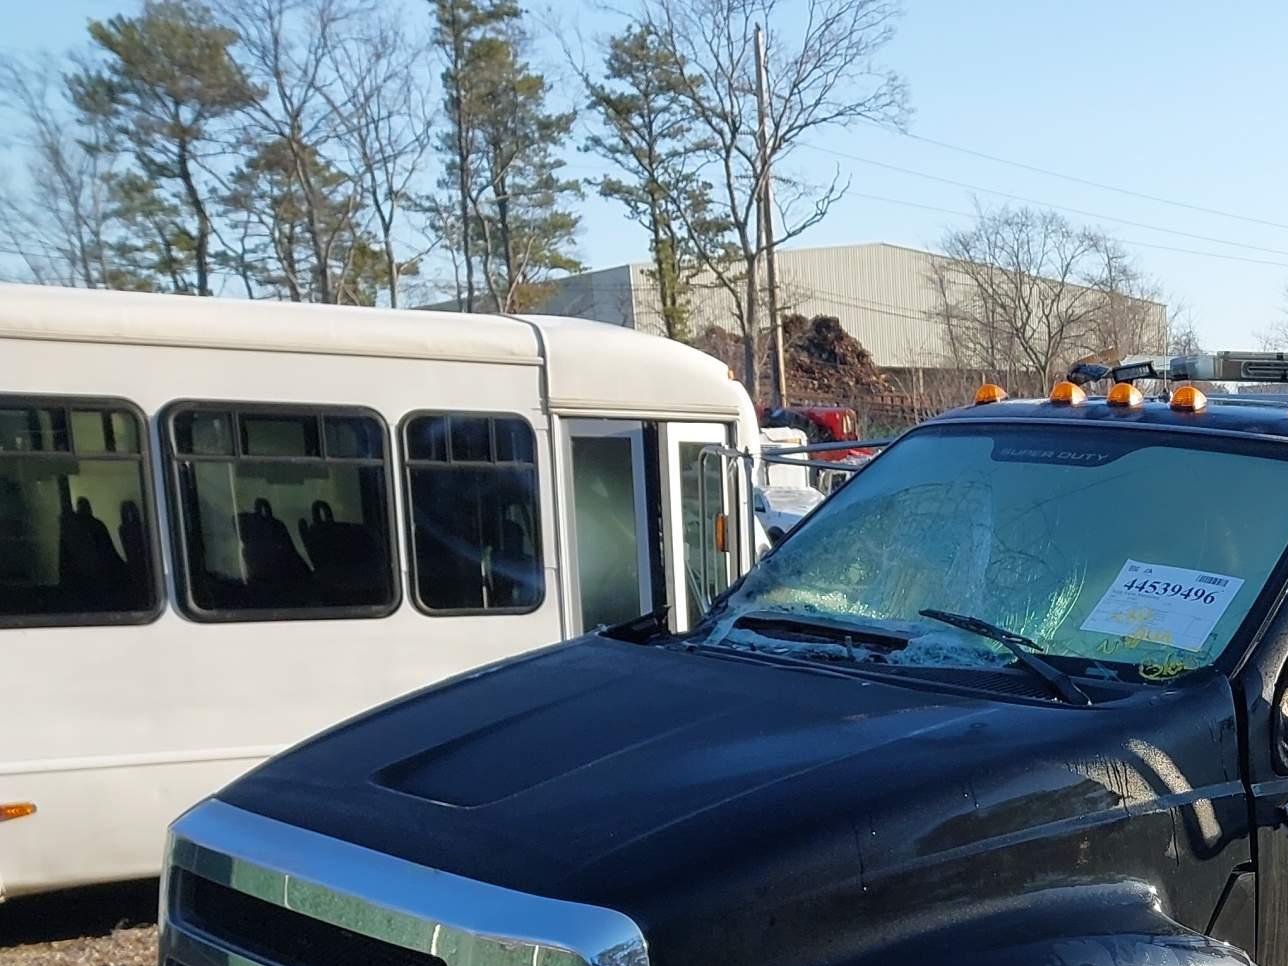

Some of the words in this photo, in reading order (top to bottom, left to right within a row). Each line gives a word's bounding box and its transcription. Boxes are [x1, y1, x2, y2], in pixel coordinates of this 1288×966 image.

[999, 447, 1054, 459] SUPER
[1058, 450, 1108, 461] DUTY
[1123, 578, 1217, 604] 44539496
